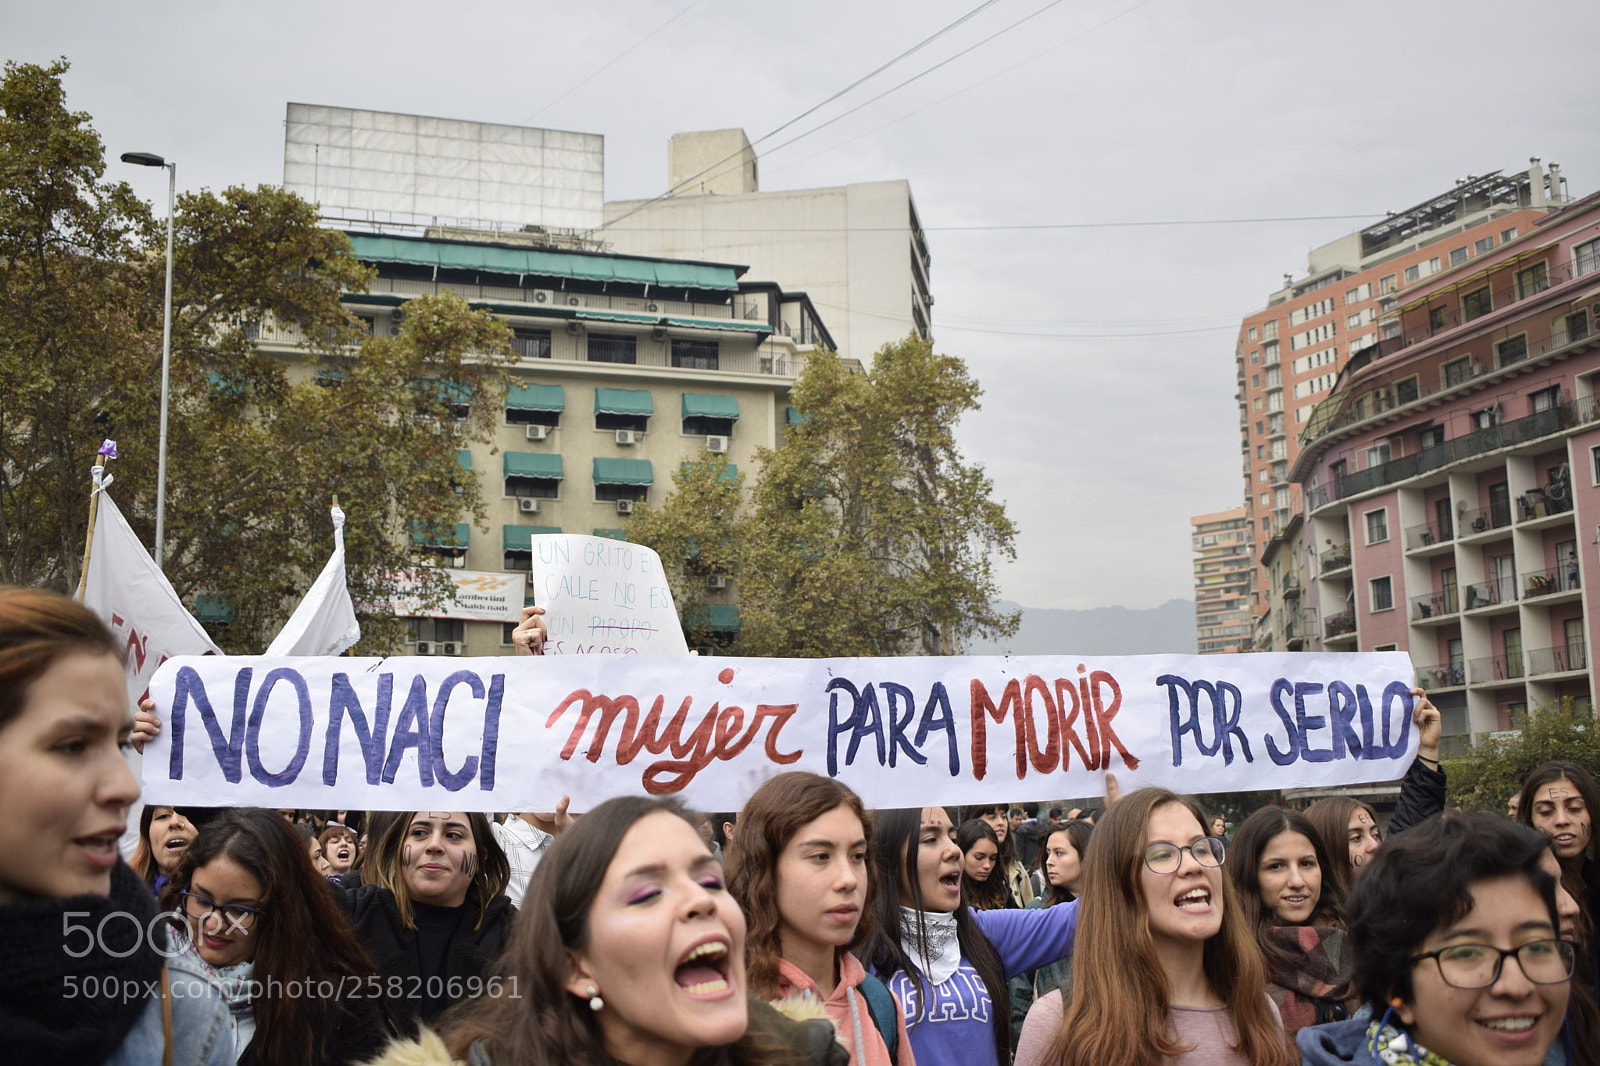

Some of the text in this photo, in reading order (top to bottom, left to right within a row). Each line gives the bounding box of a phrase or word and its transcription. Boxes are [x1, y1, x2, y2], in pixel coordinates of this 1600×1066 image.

[538, 539, 570, 565] UN
[583, 542, 633, 571] GRITO
[545, 573, 669, 609] CALLE NO ES
[550, 615, 653, 641] UN PIROPO
[169, 663, 1413, 796] NO NACI mujer PARA MORIR POR SERLO
[1548, 787, 1569, 799] ES
